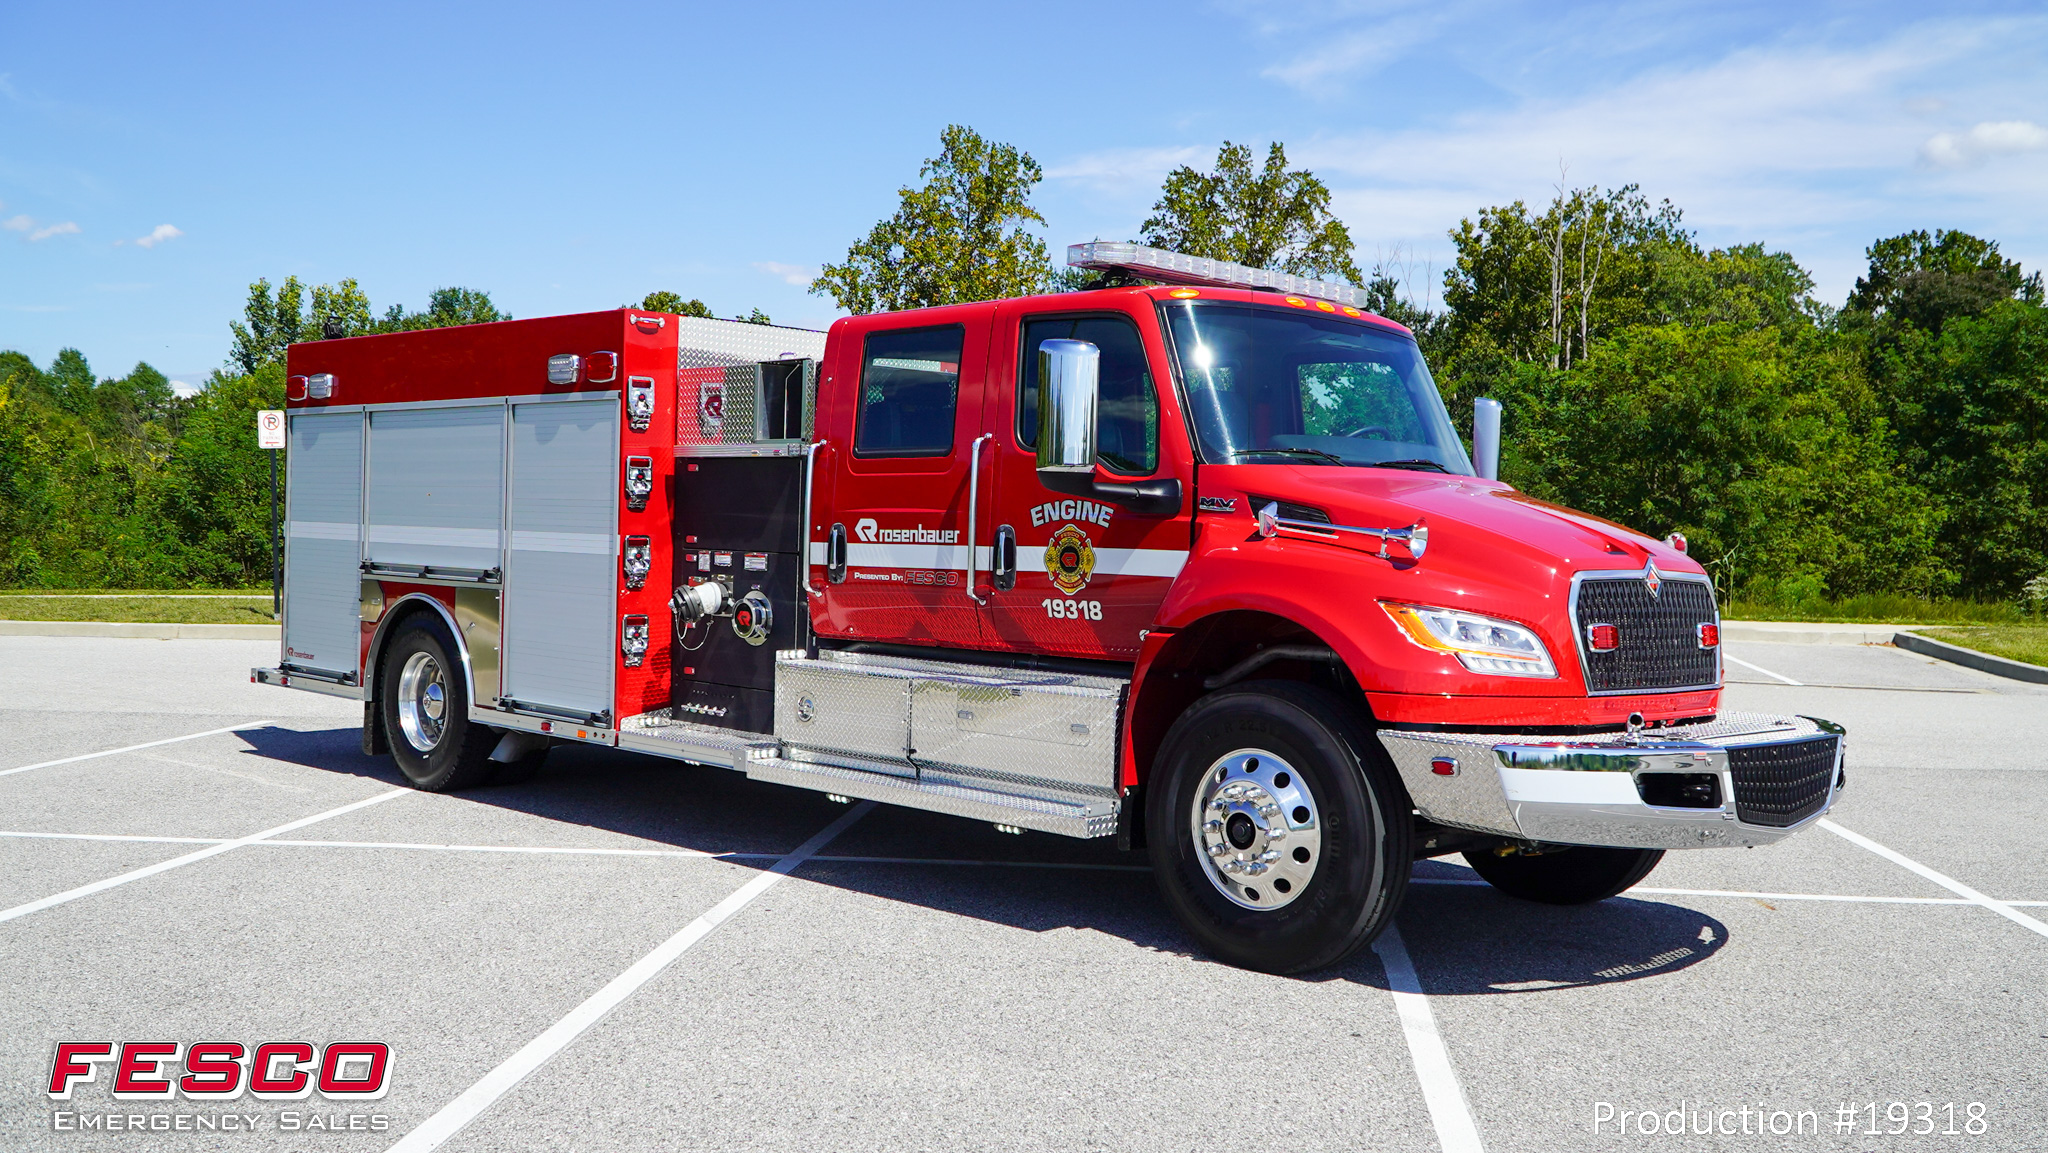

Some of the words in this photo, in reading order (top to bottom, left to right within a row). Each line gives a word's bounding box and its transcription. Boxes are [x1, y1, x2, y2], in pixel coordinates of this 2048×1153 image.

[1200, 497, 1237, 508] MV
[1030, 499, 1114, 528] ENGINE
[904, 570, 959, 586] FESCO
[1042, 598, 1103, 620] 19318
